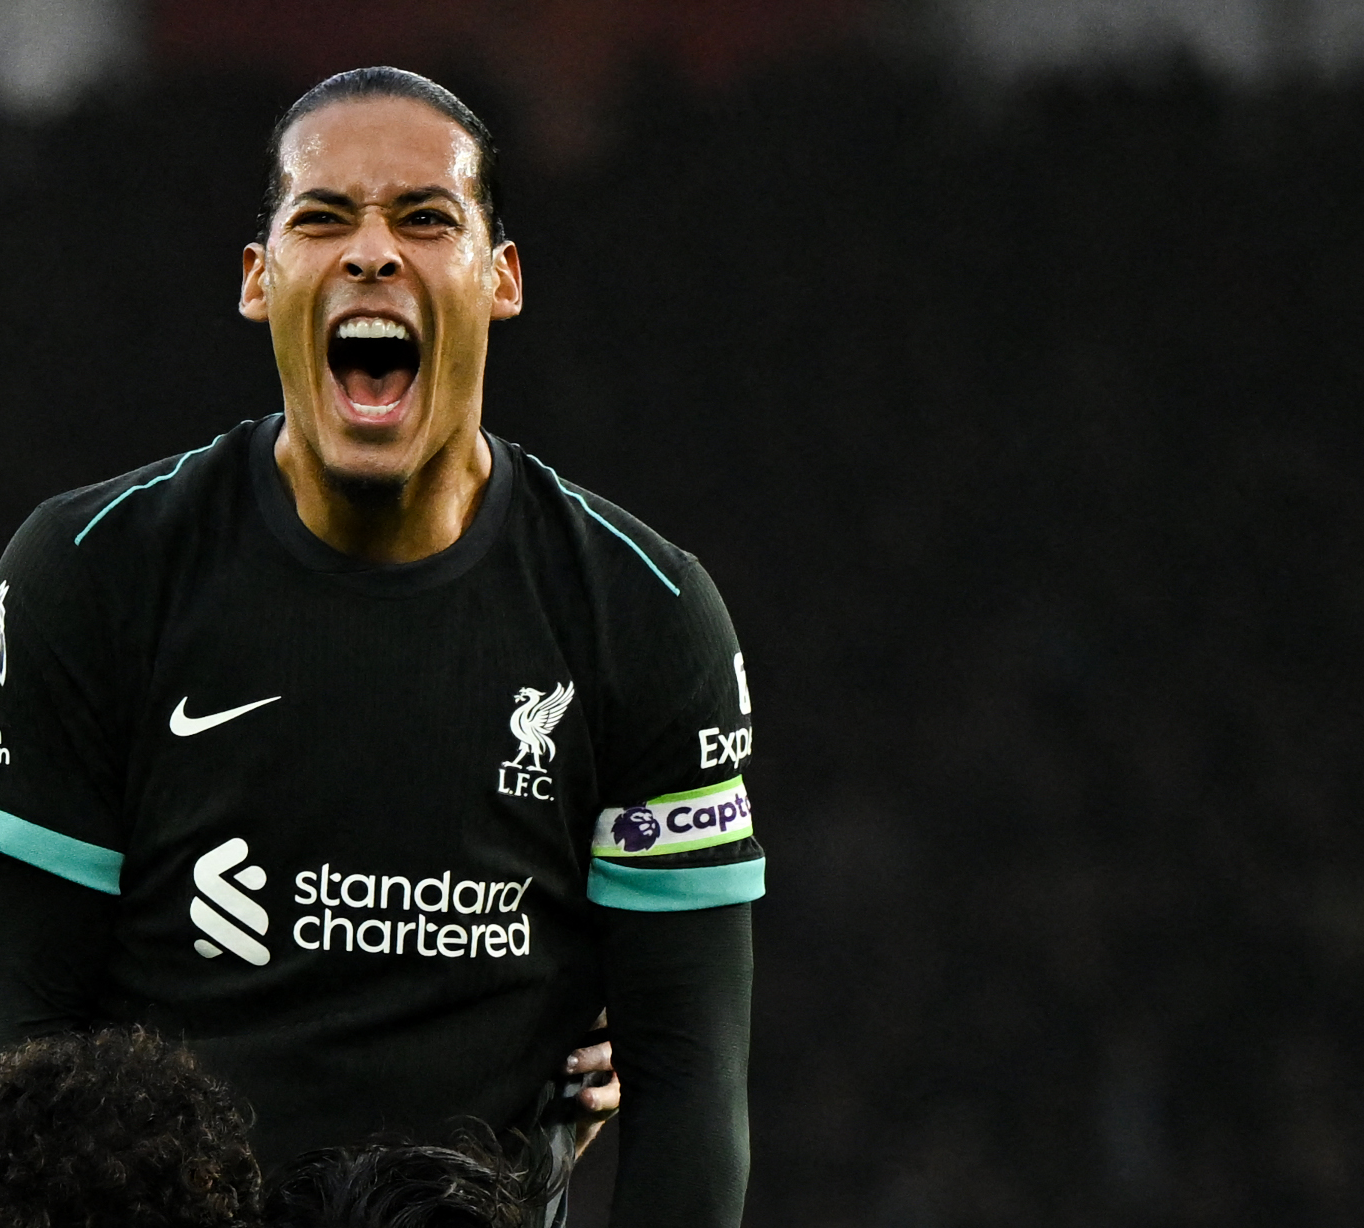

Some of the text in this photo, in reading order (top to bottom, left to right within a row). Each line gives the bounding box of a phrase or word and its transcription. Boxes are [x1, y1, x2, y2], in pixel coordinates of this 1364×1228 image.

[698, 726, 752, 769] Exp
[498, 768, 555, 801] L.F.C.
[294, 863, 533, 914] standard
[293, 908, 530, 958] chartered
